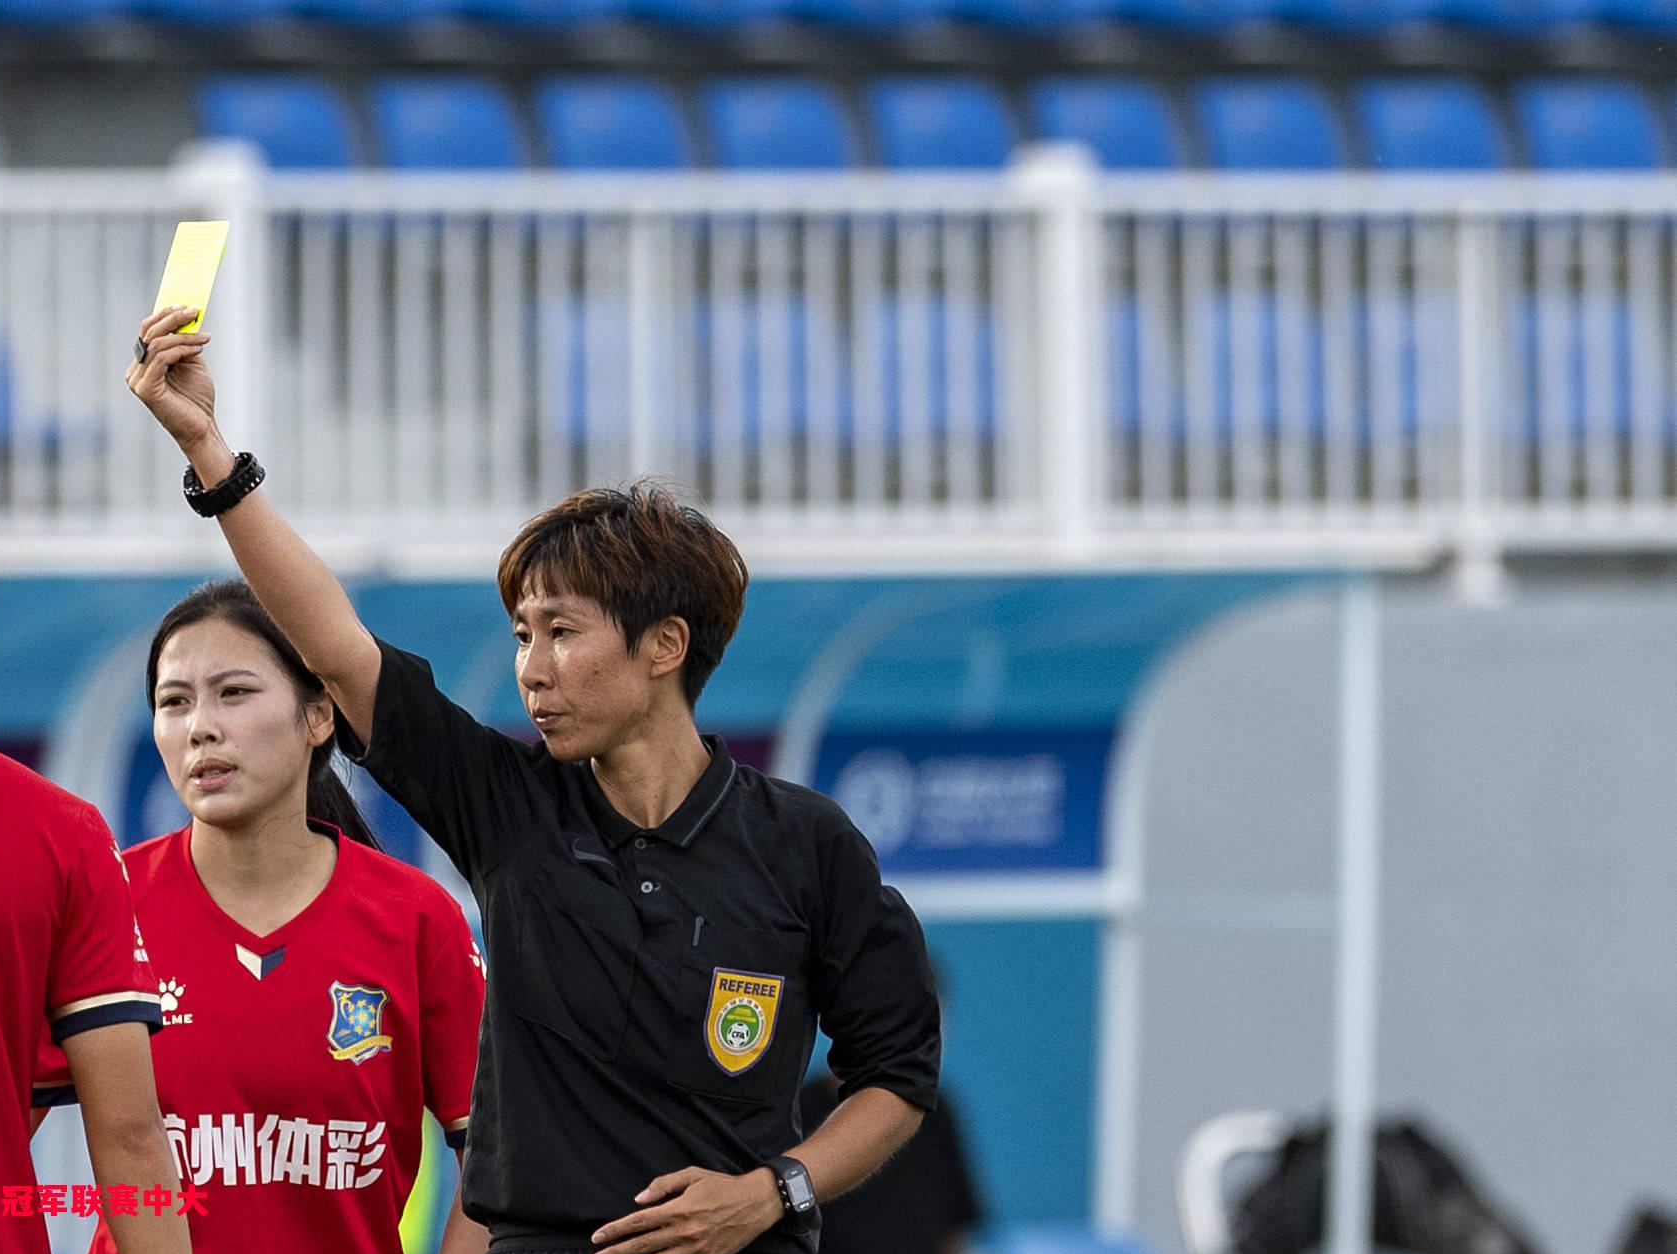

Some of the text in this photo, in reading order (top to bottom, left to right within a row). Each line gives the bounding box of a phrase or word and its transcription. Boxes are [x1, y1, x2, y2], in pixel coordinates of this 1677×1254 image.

[719, 978, 777, 997] REFEREE
[162, 1013, 193, 1026] LME
[731, 1030, 745, 1040] CFA
